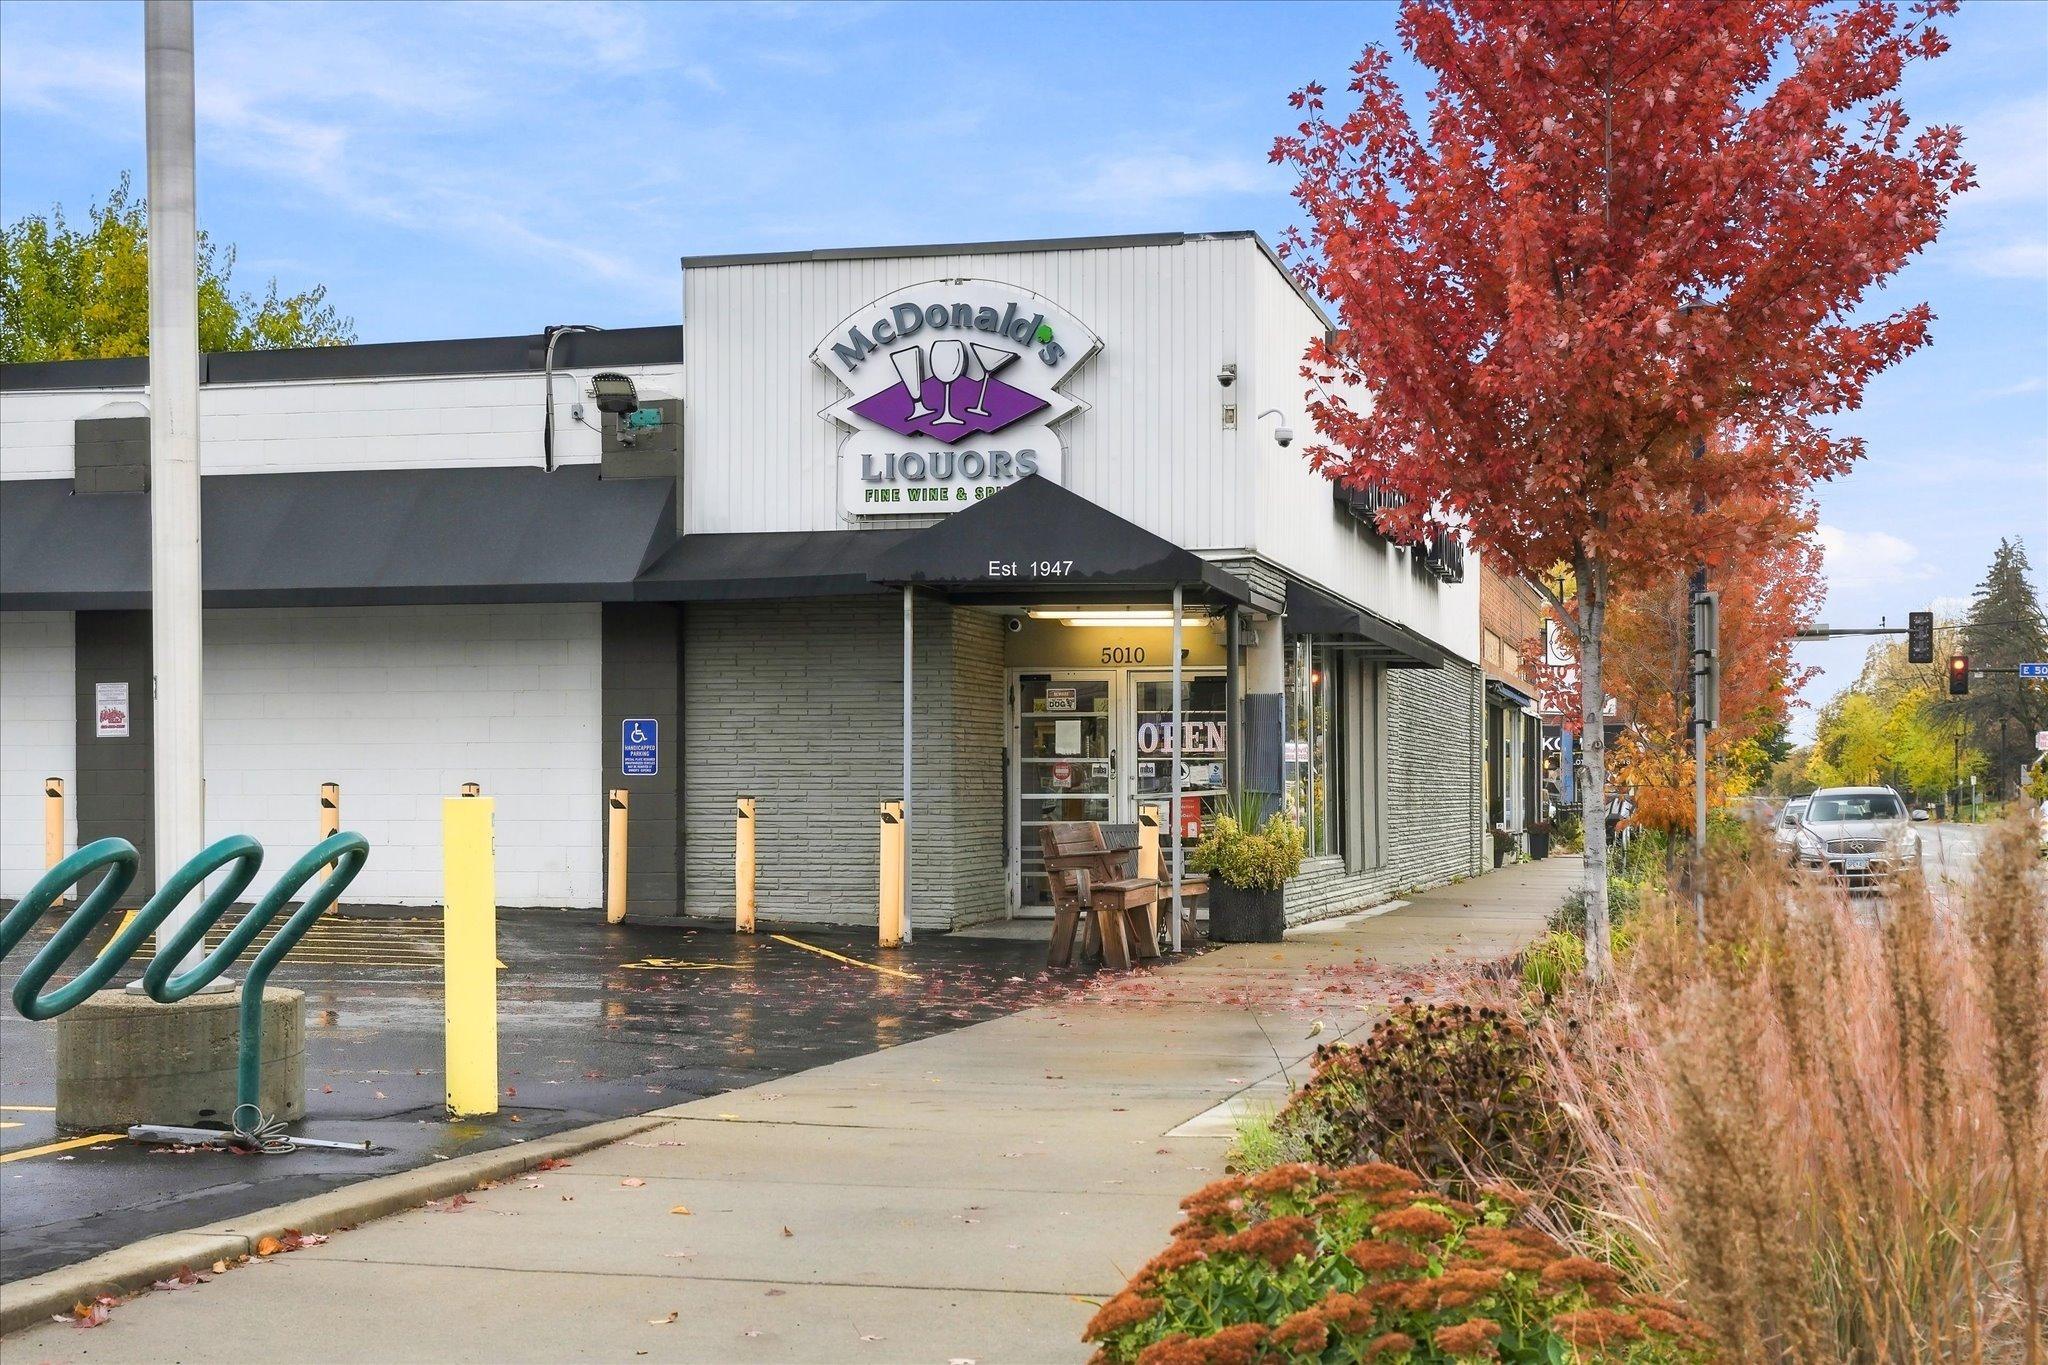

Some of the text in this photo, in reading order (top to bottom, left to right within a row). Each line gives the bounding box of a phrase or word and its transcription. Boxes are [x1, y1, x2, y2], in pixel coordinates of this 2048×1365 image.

[831, 302, 1067, 372] McDonald's
[861, 449, 1038, 481] LIQUORS
[865, 488, 900, 502] FINE
[908, 488, 949, 502] WINE
[956, 486, 967, 501] &
[988, 560, 1074, 577] Est 1947
[1101, 646, 1145, 665] 5010
[2023, 666, 2030, 675] E
